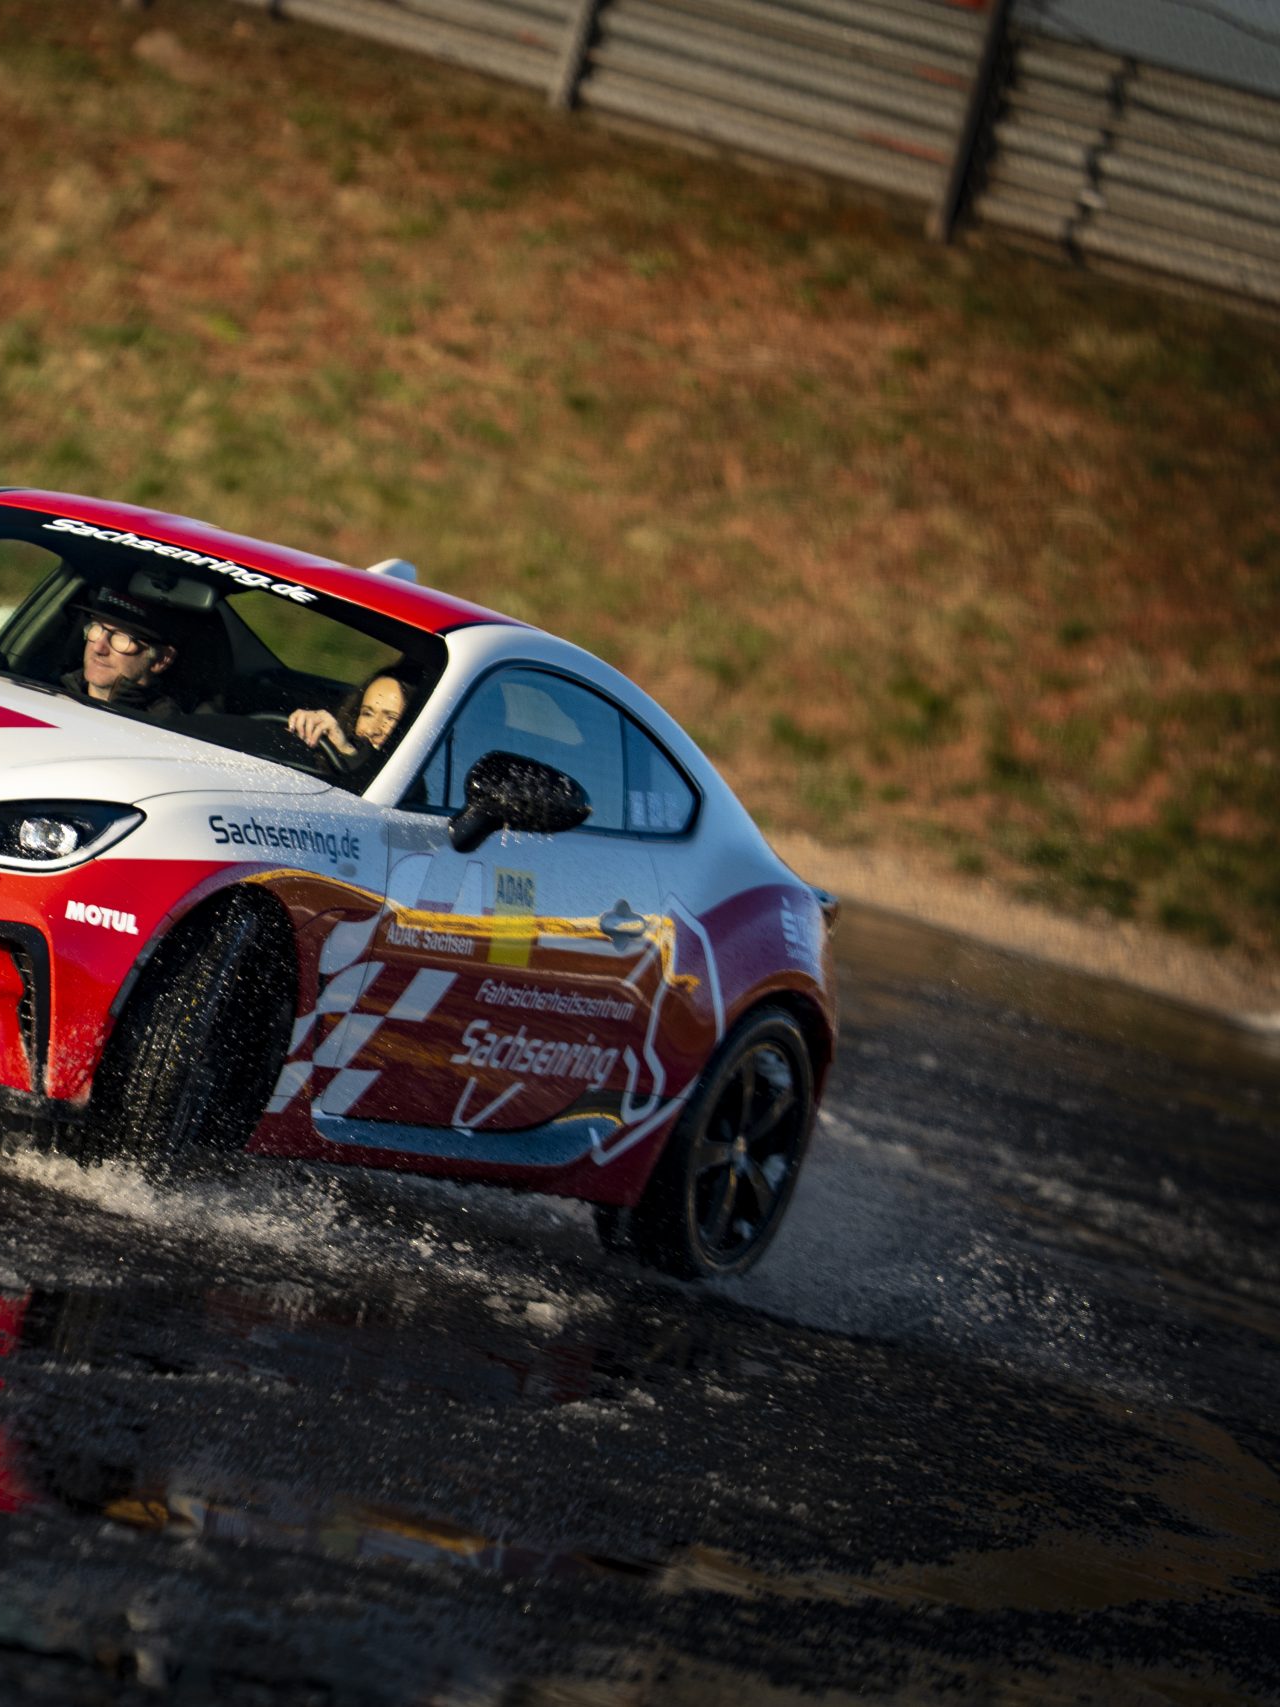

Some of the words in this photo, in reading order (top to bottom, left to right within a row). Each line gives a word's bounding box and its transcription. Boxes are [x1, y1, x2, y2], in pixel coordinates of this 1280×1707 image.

[42, 518, 319, 603] Sachsenring.de
[209, 815, 360, 864] Sachsenring.de
[496, 873, 535, 908] ADAC
[64, 900, 139, 935] MOTUL
[385, 922, 420, 949] ADAC
[422, 927, 475, 956] Sachsen
[449, 1018, 619, 1091] Sachsenring
